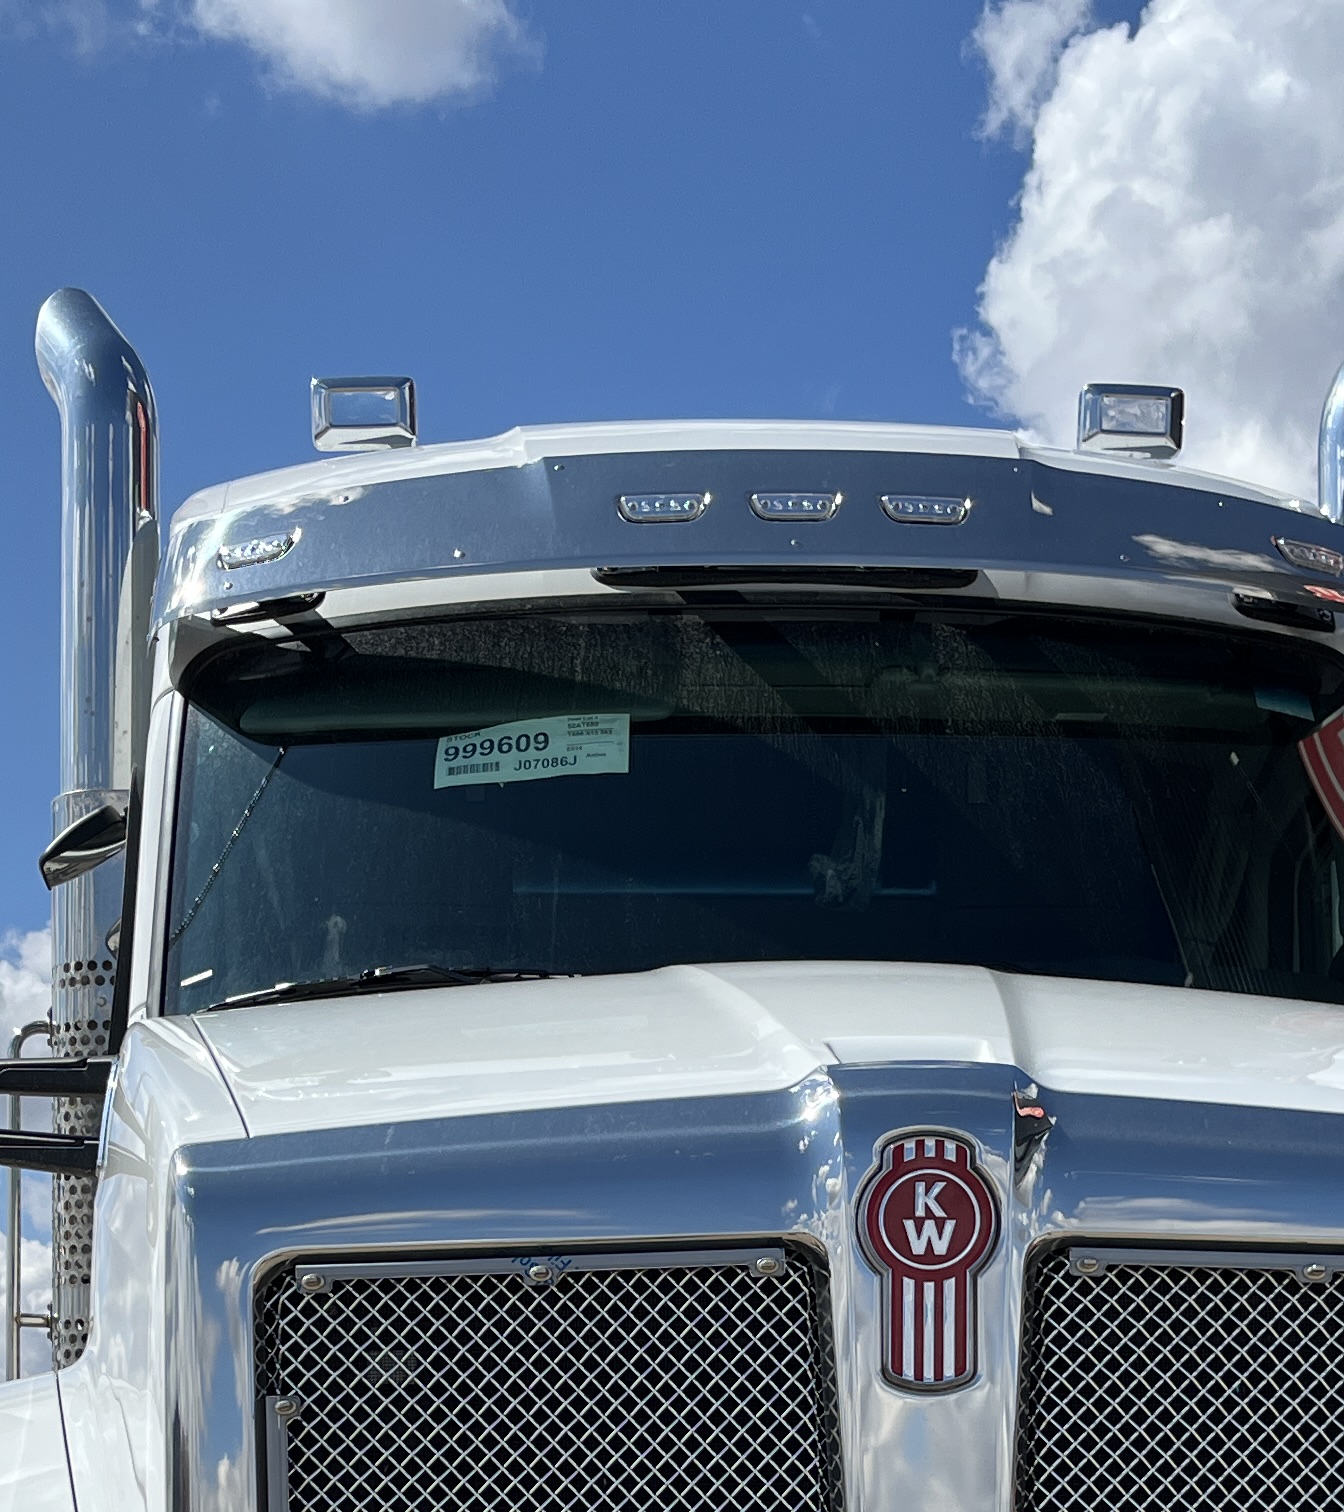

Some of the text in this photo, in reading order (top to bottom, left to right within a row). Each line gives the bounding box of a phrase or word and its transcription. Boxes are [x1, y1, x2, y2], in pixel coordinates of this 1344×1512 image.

[443, 731, 550, 762] 999609
[513, 754, 577, 771] J07086J
[915, 1181, 947, 1217] K
[902, 1219, 957, 1255] W
